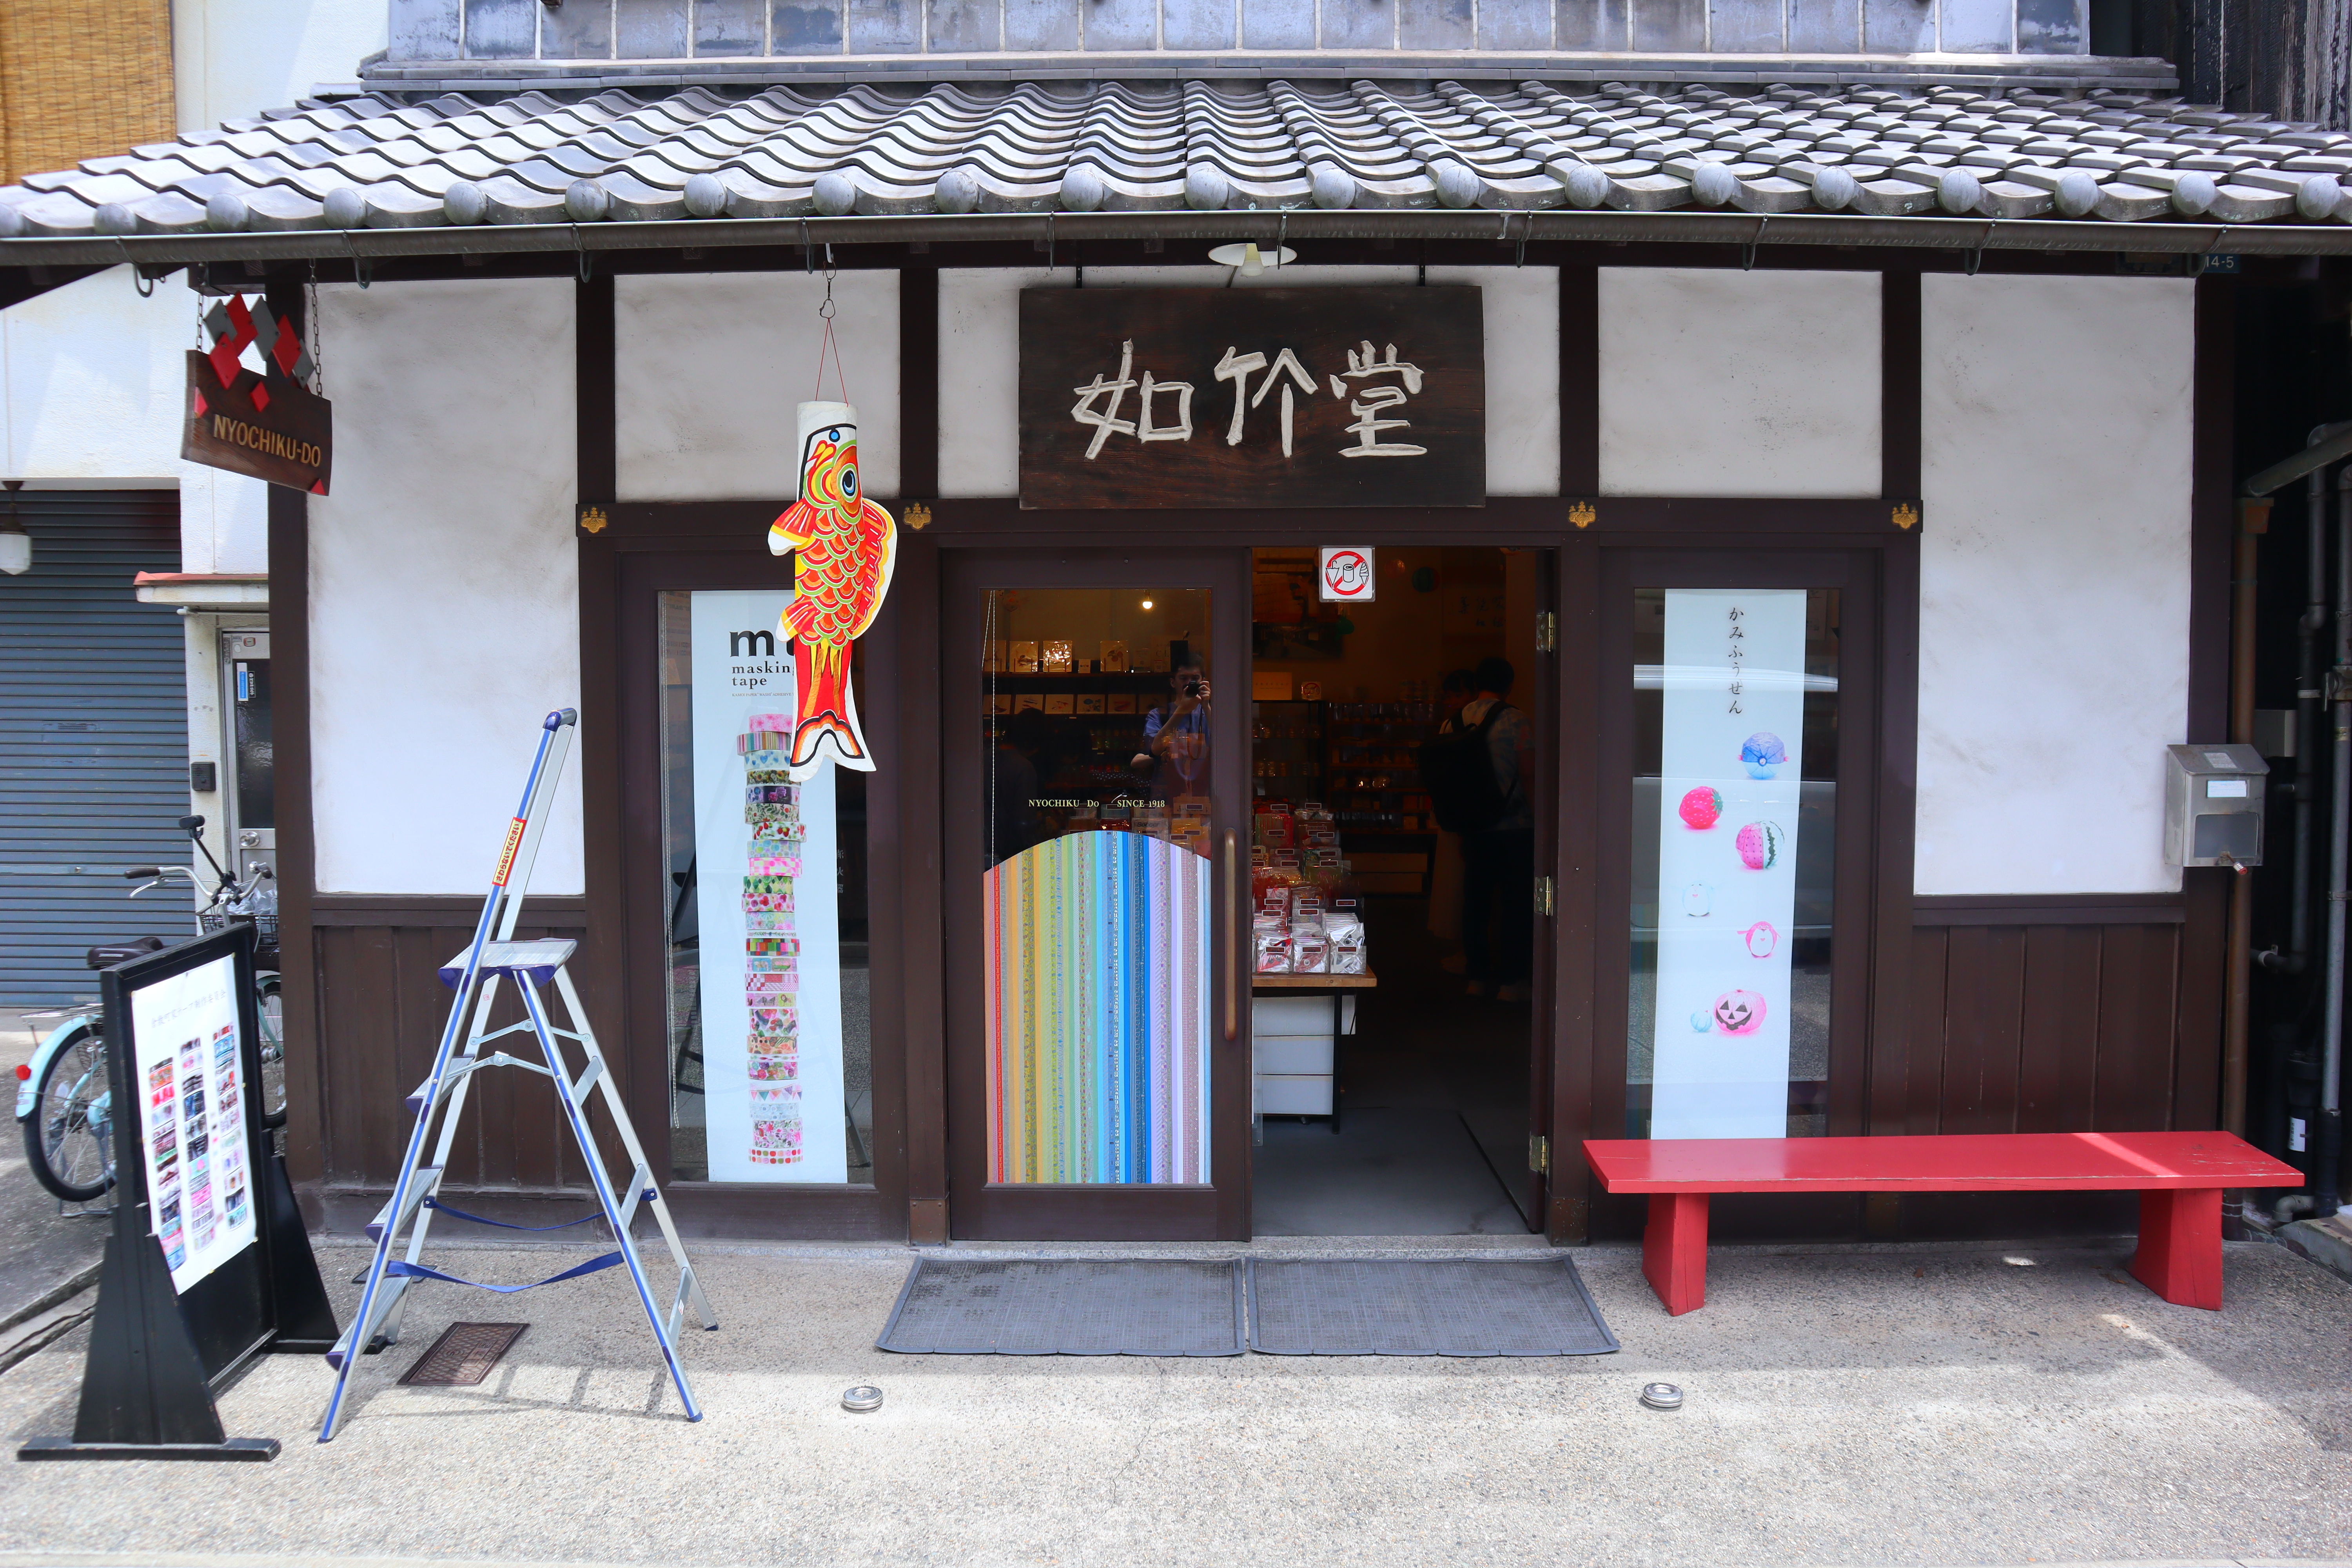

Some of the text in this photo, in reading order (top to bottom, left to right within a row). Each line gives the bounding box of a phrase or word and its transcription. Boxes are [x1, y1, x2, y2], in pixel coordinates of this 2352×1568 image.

[2206, 256, 2234, 268] 14-5
[1070, 337, 1428, 460] 如竹堂
[213, 414, 321, 468] NYOCHIKU-DO
[730, 630, 794, 657] m
[731, 661, 794, 675] maskin
[1728, 607, 1744, 714] かみふうせん
[731, 677, 768, 690] tape
[1028, 799, 1080, 808] NYOCHIKU
[1117, 799, 1145, 808] SINCE
[1148, 799, 1165, 808] 1918
[496, 823, 520, 882] さわらないでください
